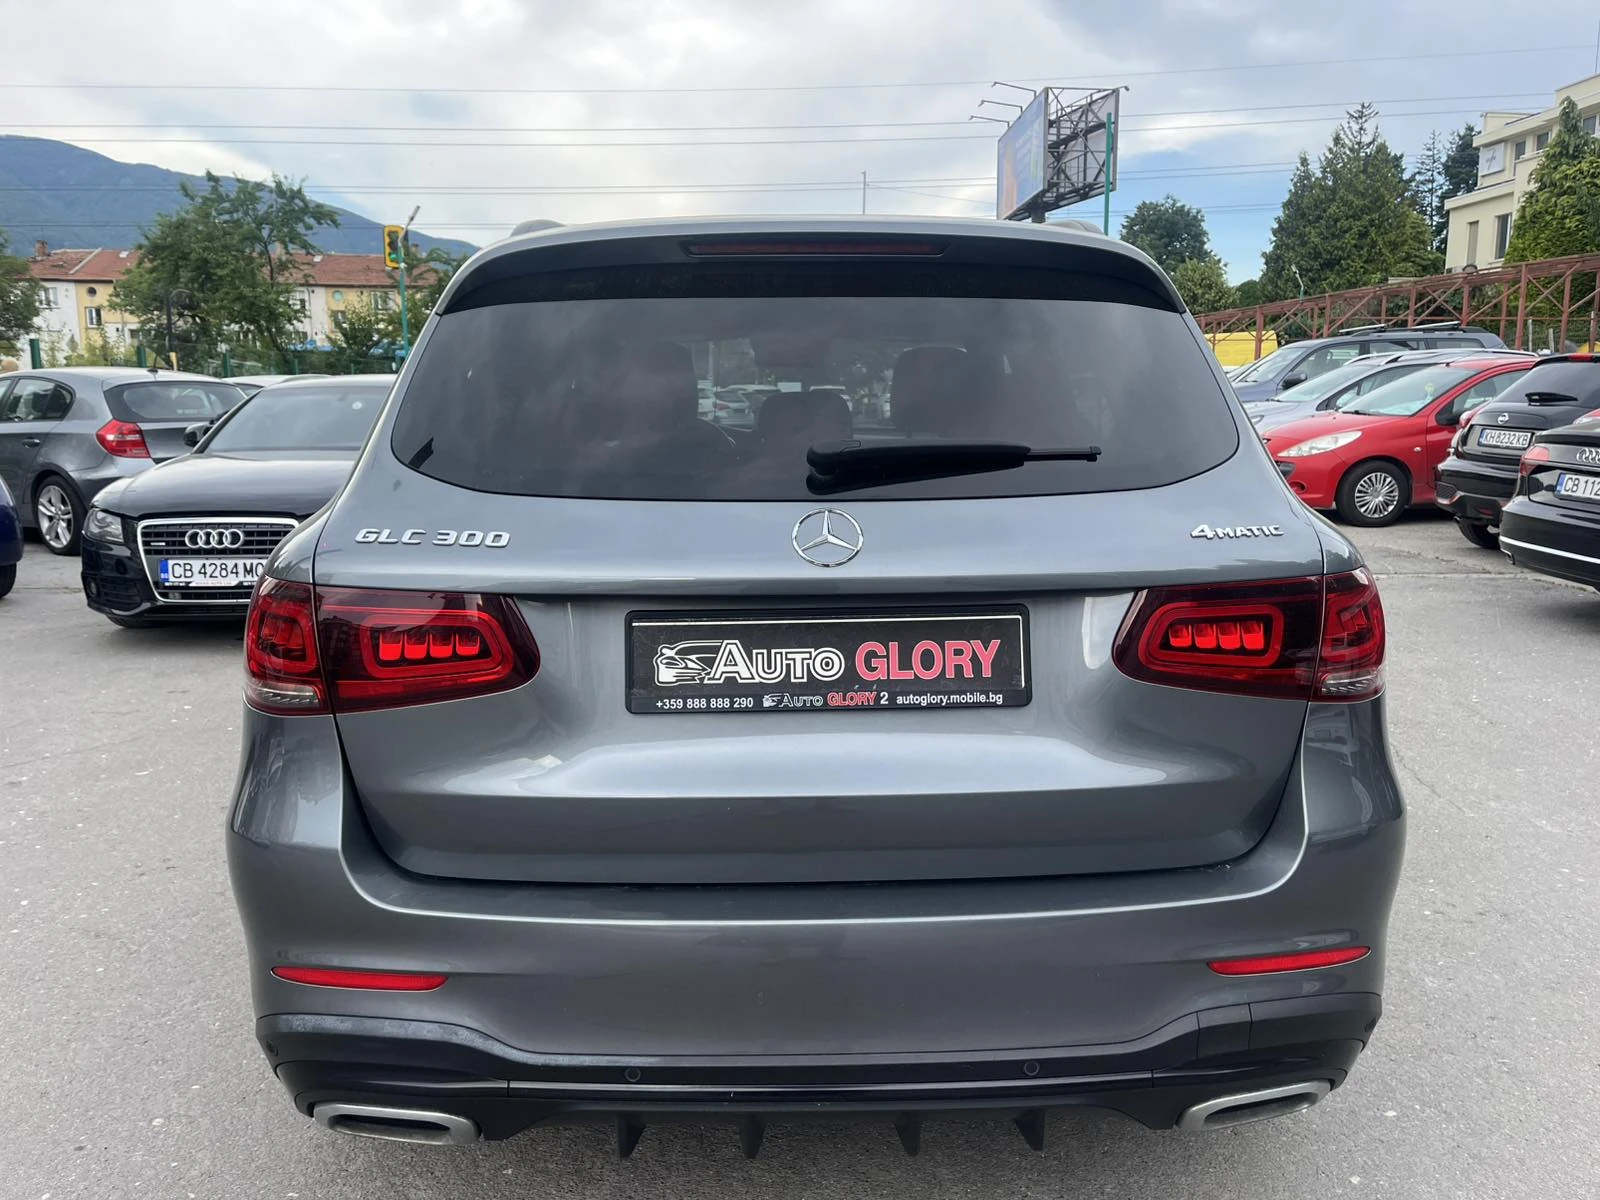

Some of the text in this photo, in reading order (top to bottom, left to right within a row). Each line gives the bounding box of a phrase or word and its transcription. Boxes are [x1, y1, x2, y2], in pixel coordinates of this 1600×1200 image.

[1564, 477, 1580, 493] CB
[355, 528, 511, 548] GLC 300
[1190, 524, 1285, 540] 4MATIC
[171, 562, 194, 579] CB
[198, 562, 239, 579] 4284
[703, 639, 1001, 684] AUTO GLORY
[655, 691, 1004, 710] +359 888 888 290 AUTO GLORY 2 autoglory.mobile.bg
